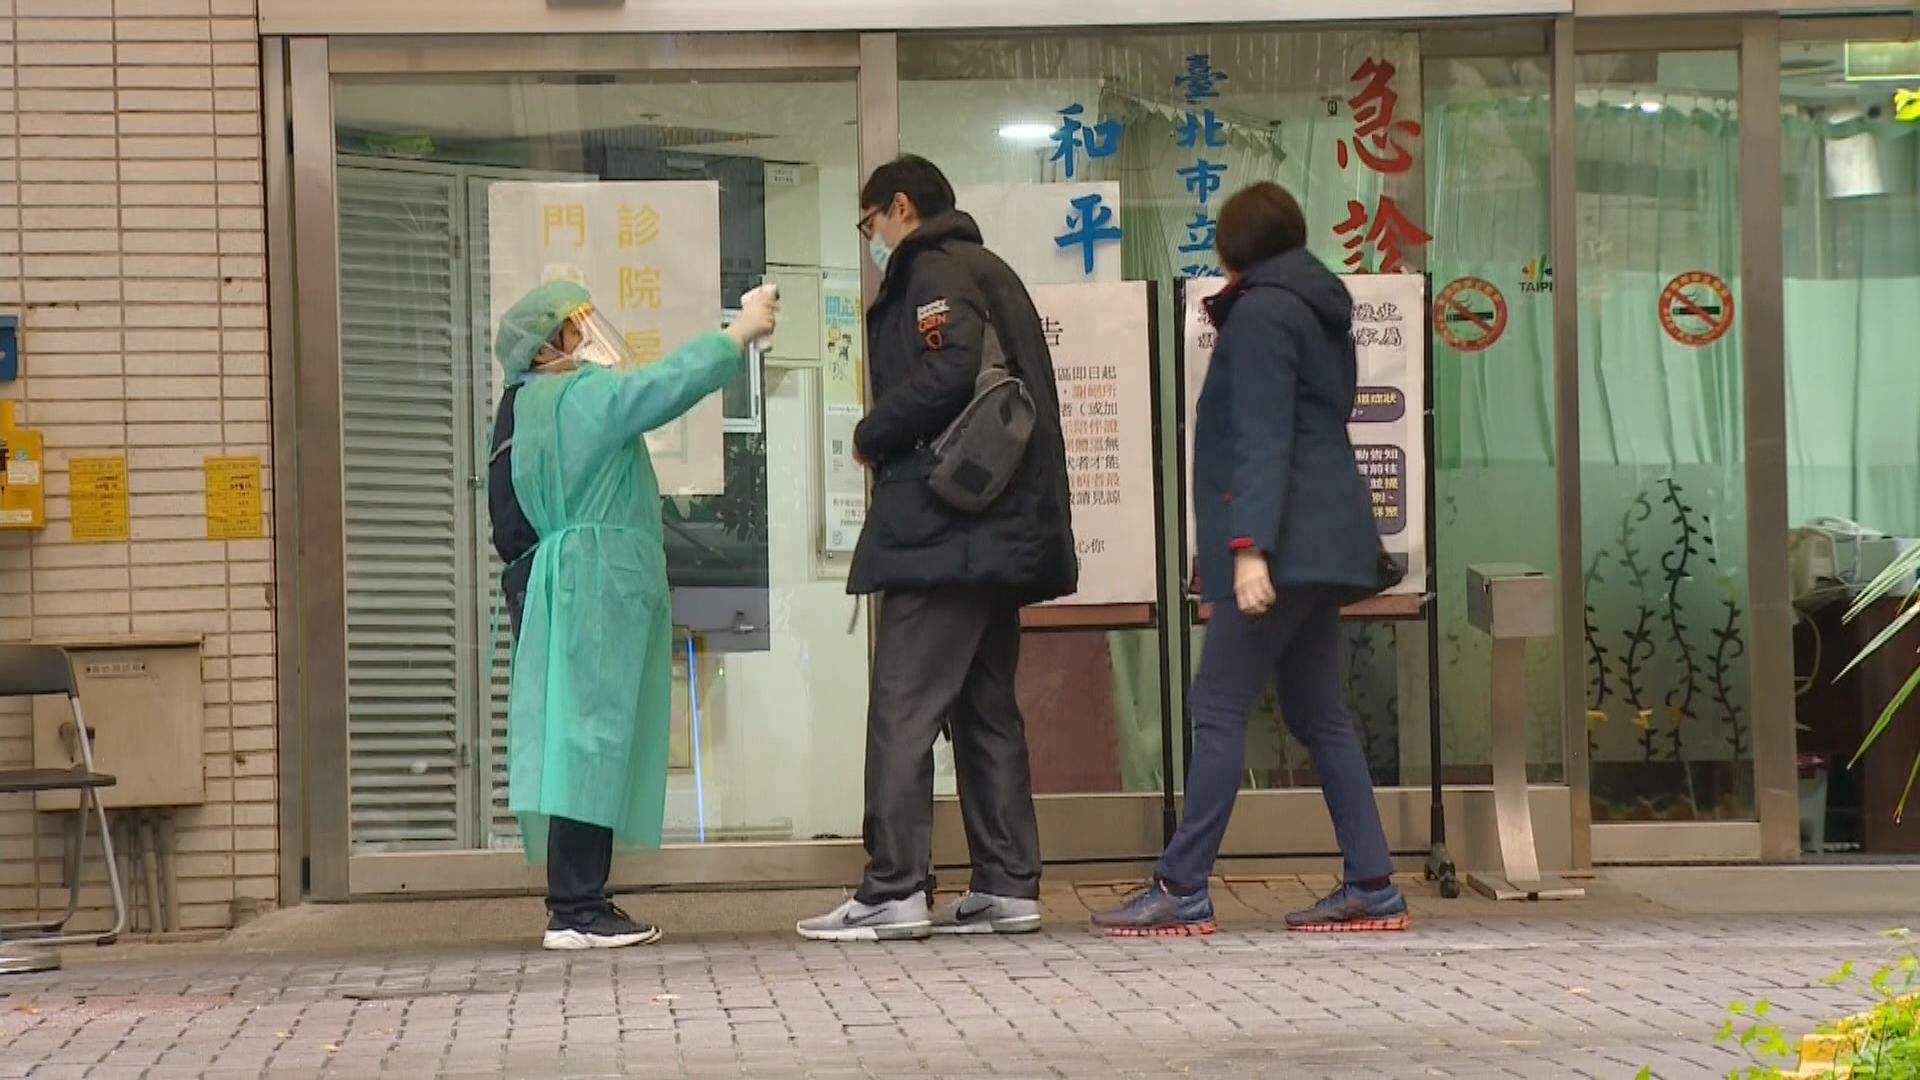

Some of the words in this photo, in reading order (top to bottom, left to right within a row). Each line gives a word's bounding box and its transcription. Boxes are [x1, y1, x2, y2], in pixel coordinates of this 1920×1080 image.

[1049, 102, 1122, 275] 和平
[1333, 56, 1433, 273] 急診
[543, 203, 660, 248] 門診
[1054, 366, 1117, 381] 區即日起
